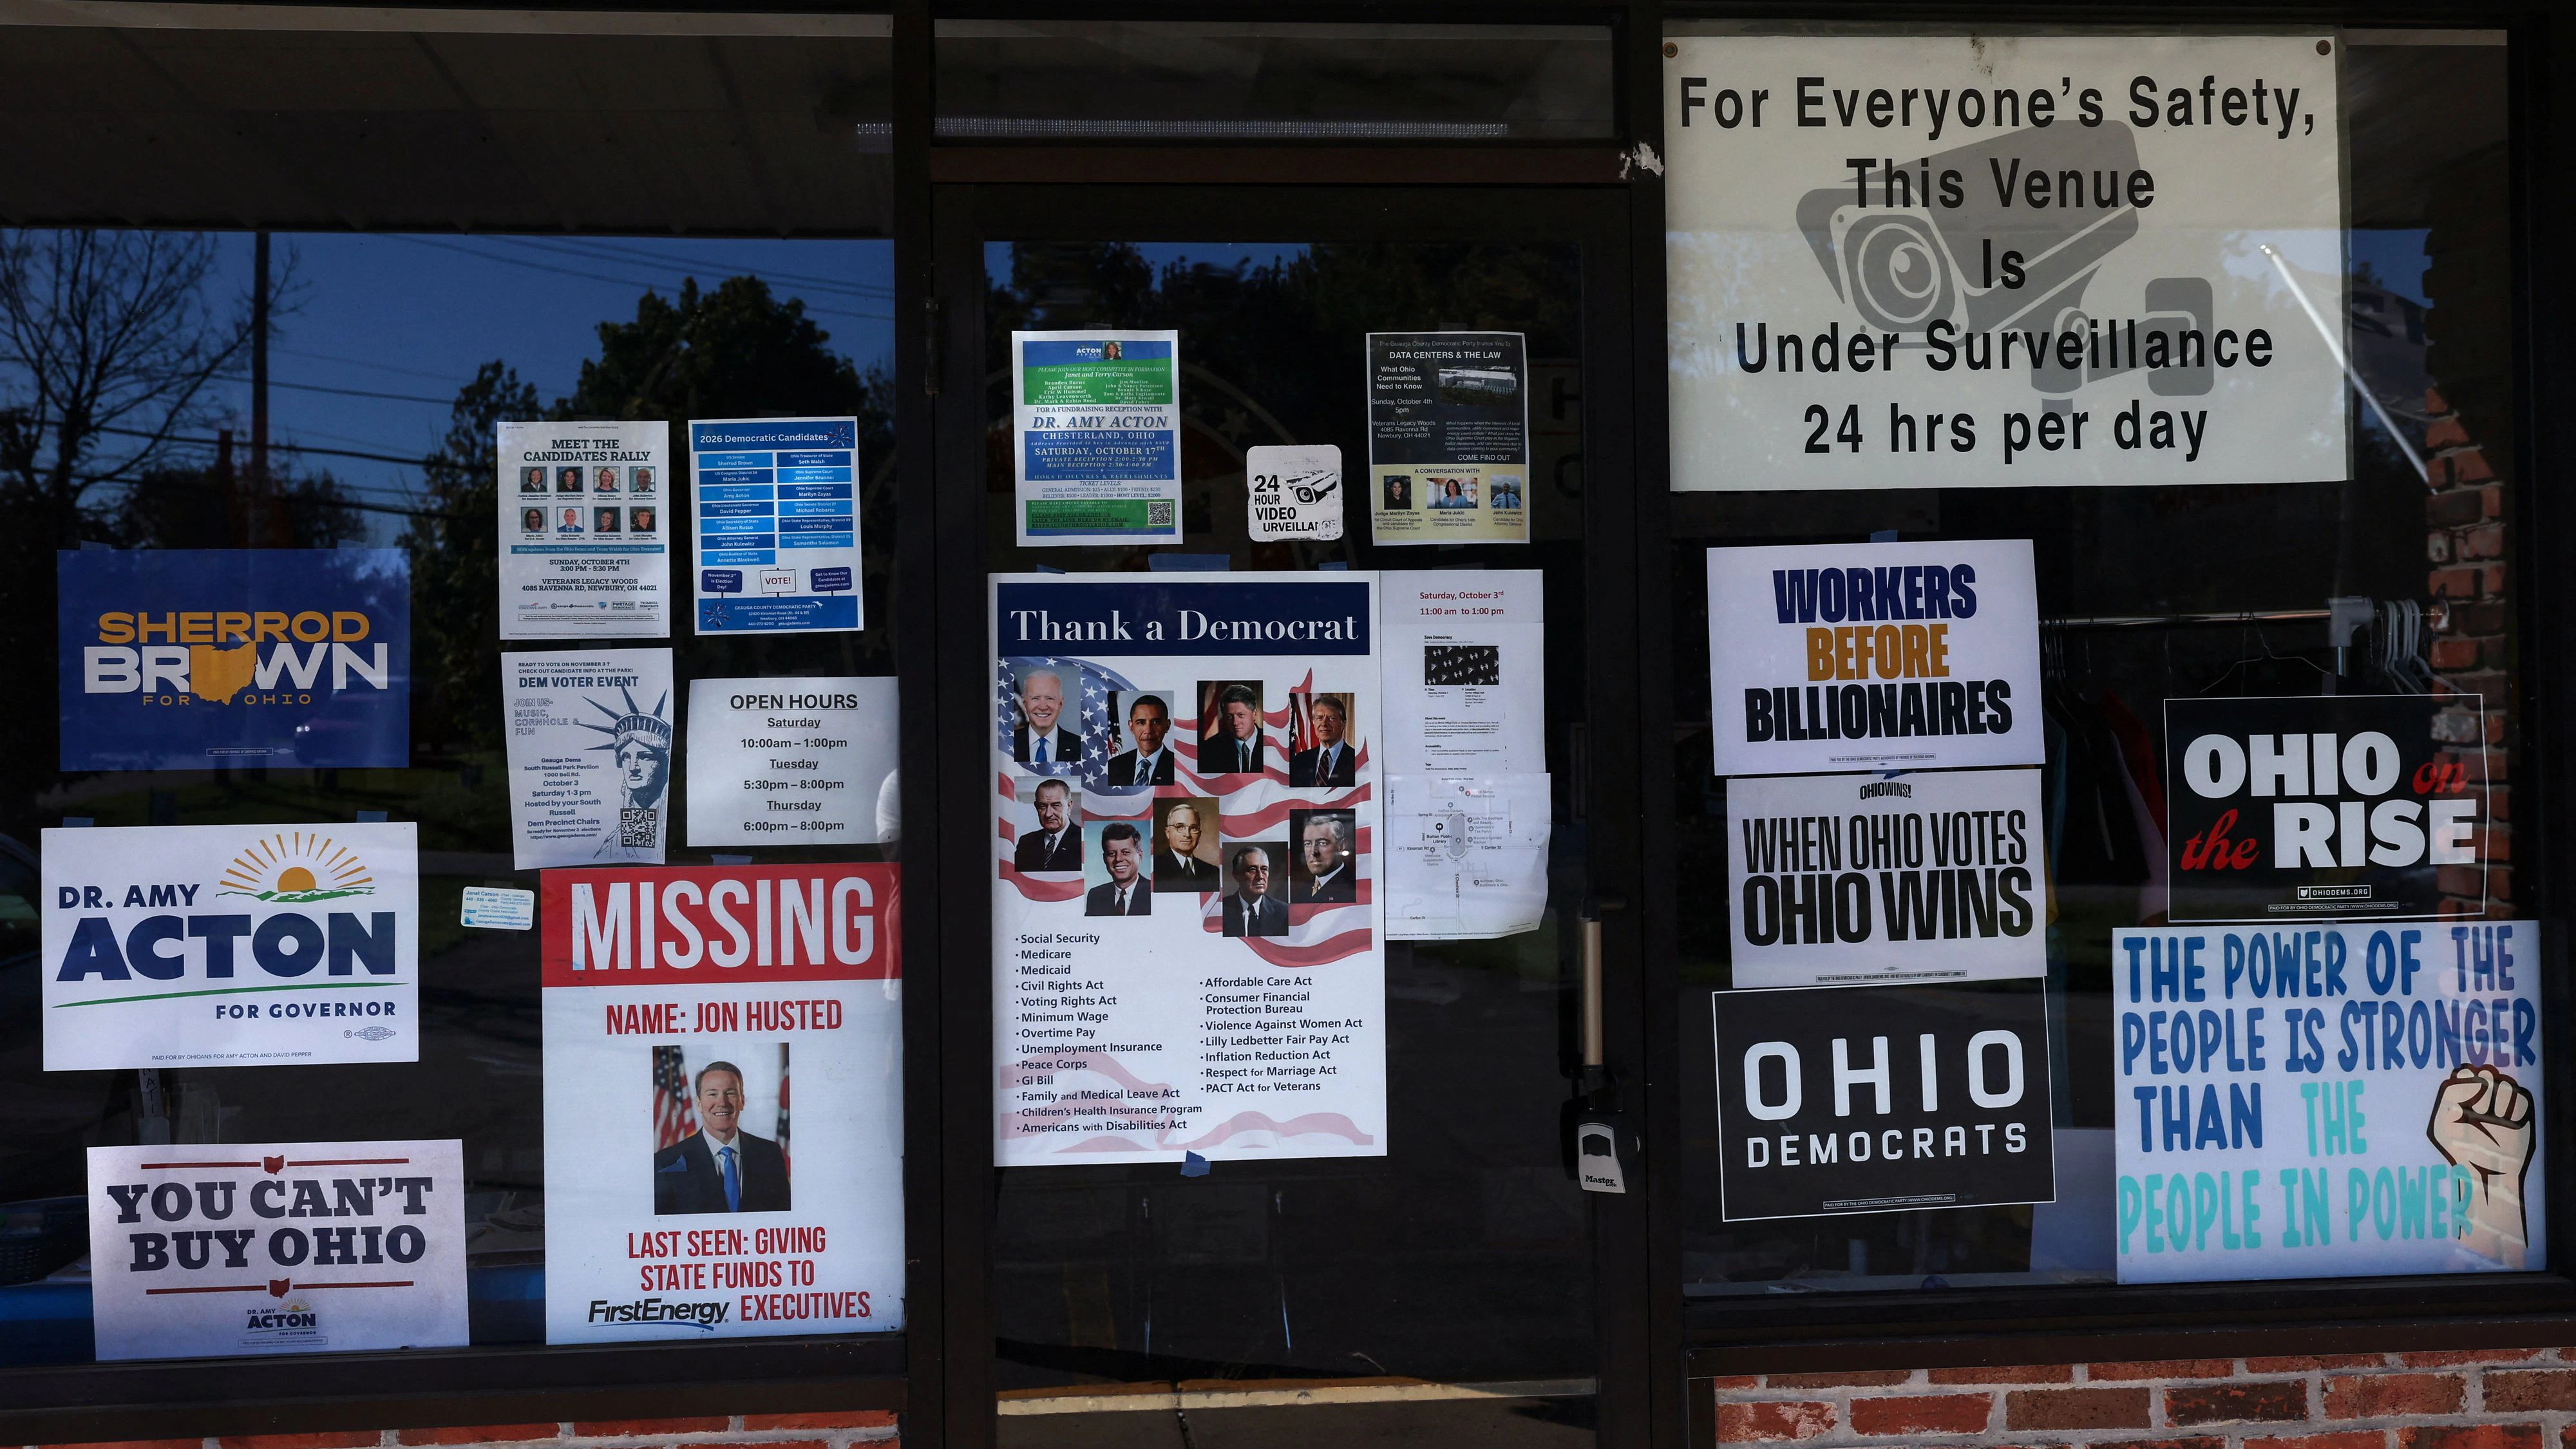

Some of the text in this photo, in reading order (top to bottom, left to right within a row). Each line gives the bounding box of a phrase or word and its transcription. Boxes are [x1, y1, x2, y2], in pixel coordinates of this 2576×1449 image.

[1681, 75, 2313, 140] For Everyone's Safety,
[1846, 158, 2154, 209] This Venue
[1983, 239, 2025, 289] Is
[1737, 319, 2272, 373] Under Surveillance
[1032, 417, 1168, 428] DR. AMY ACTON
[1804, 400, 2207, 464] 24 hrs per day
[524, 451, 650, 461] CANDIDATES RALLY
[552, 440, 619, 449] MEET THE
[1255, 475, 1280, 492] 24
[1255, 495, 1280, 505] HOUR
[1255, 507, 1296, 520] VIDEO
[1420, 590, 1504, 600] Saturday, October 3rd
[1773, 564, 1976, 623] WORKERS
[99, 612, 369, 643] SHERROD
[1011, 611, 1358, 640] Thank a Democrat
[1806, 623, 1949, 681] BEFORE
[84, 643, 388, 693] BRWN
[520, 676, 638, 688] DEM VOTER EVENT
[144, 694, 310, 705] FOR OHIO
[731, 694, 858, 710] OPEN HOURS
[1745, 679, 2012, 742] BILLIONAIRES
[768, 717, 820, 728] Saturday
[741, 739, 847, 749] 10:00am 1:00pm
[770, 759, 819, 770] Tuesday
[2184, 732, 2470, 798] OHIO on
[744, 780, 844, 791] 5:30pm 8:00pm
[1860, 782, 1911, 800] OHIOWINS!
[767, 800, 821, 811] Thursday
[744, 821, 844, 833] 6:00pm 8:00pm
[1743, 810, 2026, 873] WHEN OHIO VOTES
[2181, 799, 2476, 870] the RISE
[59, 884, 200, 909] DR. AMY
[1743, 867, 2032, 946] OHIO WINS
[572, 877, 873, 970] MISSING
[56, 912, 395, 981] ACTON
[1021, 933, 1099, 945] Social Security
[1021, 949, 1071, 959] Medicare
[2123, 925, 2515, 1003] THE POWER OF THE
[1022, 965, 1070, 974] Medicaid
[1206, 977, 1312, 987] Affordable Care Act
[1021, 980, 1103, 992] Civil Rights Act
[216, 1002, 395, 1019] FOR GOVERNOR
[1021, 996, 1117, 1008] Voting Rights Act
[607, 1000, 842, 1035] NAME: JON HUSTED
[2123, 998, 2535, 1075] PEOPLE IS STRONGER
[1745, 1030, 2023, 1120] OHIO
[2134, 1080, 2367, 1157] THAN THE
[1748, 1123, 2025, 1168] DEMOCRATS
[1586, 1175, 1615, 1185] Master
[107, 1177, 433, 1224] YOU CAN'T
[2119, 1164, 2472, 1255] PEOPLE IN POWER
[129, 1225, 426, 1272] BUY OHIO
[629, 1227, 825, 1258] LAST SEEN: GIVING
[641, 1260, 814, 1291] STATE FUNDS TO
[741, 1291, 871, 1321] EXECUTIVES
[247, 1314, 316, 1330] ACTON
